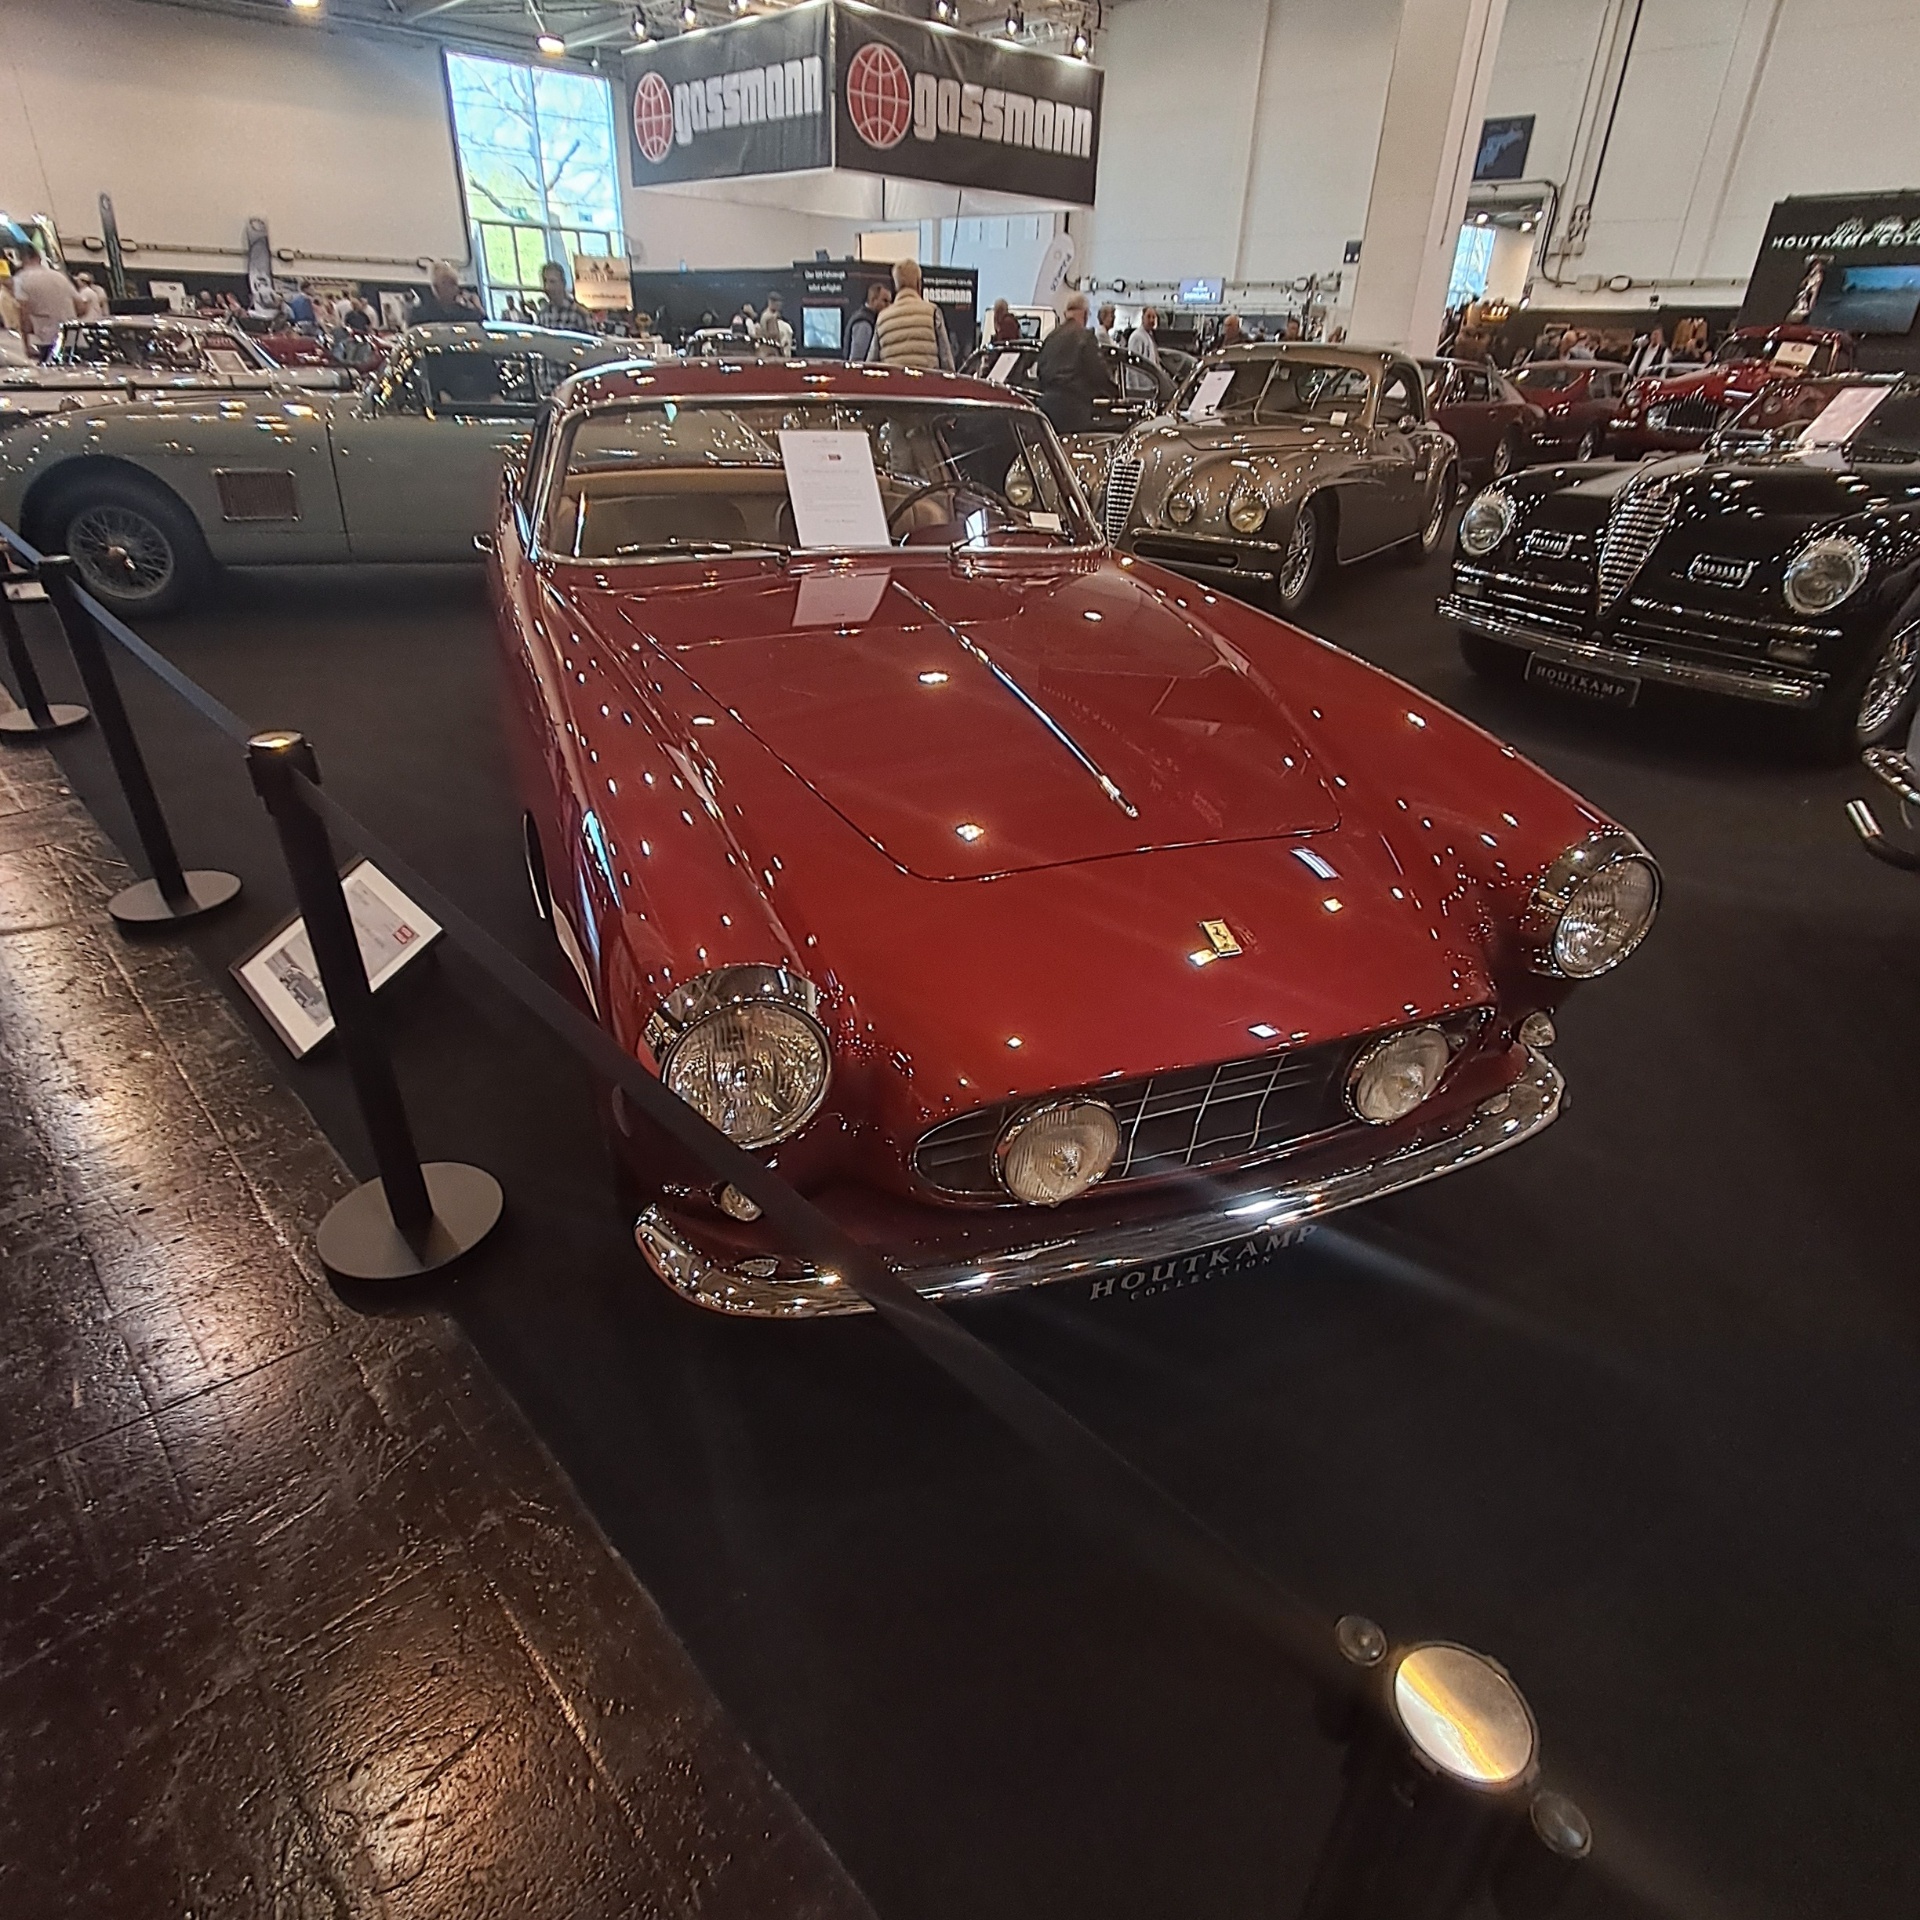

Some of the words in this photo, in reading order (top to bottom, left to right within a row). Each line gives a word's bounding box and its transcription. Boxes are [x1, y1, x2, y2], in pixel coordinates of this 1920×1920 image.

[673, 55, 823, 146] gassmann
[913, 72, 1093, 159] gassmann
[1878, 232, 1920, 247] COL
[1536, 665, 1625, 696] HOUTKAMP
[1089, 1225, 1319, 1301] HOUTKAMP
[1131, 1255, 1272, 1300] COLLECTION
